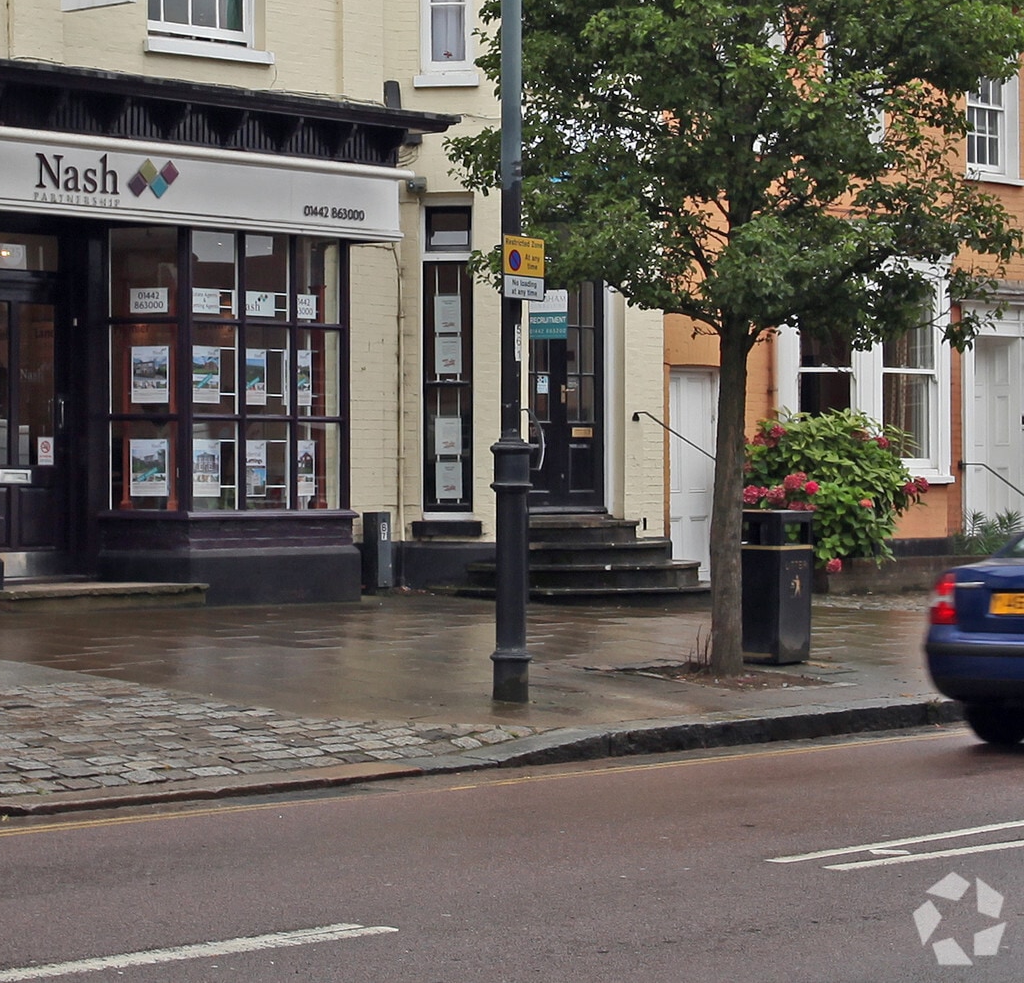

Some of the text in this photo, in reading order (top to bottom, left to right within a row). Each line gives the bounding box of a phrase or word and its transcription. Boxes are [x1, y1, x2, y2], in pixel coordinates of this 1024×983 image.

[35, 152, 120, 195] Nash
[34, 191, 121, 207] PARTNERSHIP
[303, 204, 365, 221] 01442 863000
[505, 238, 543, 249] Restricted Zone
[137, 292, 160, 300] 01442
[134, 300, 163, 310] 863000
[246, 301, 261, 312] ash
[530, 316, 566, 324] RECRUITMENT
